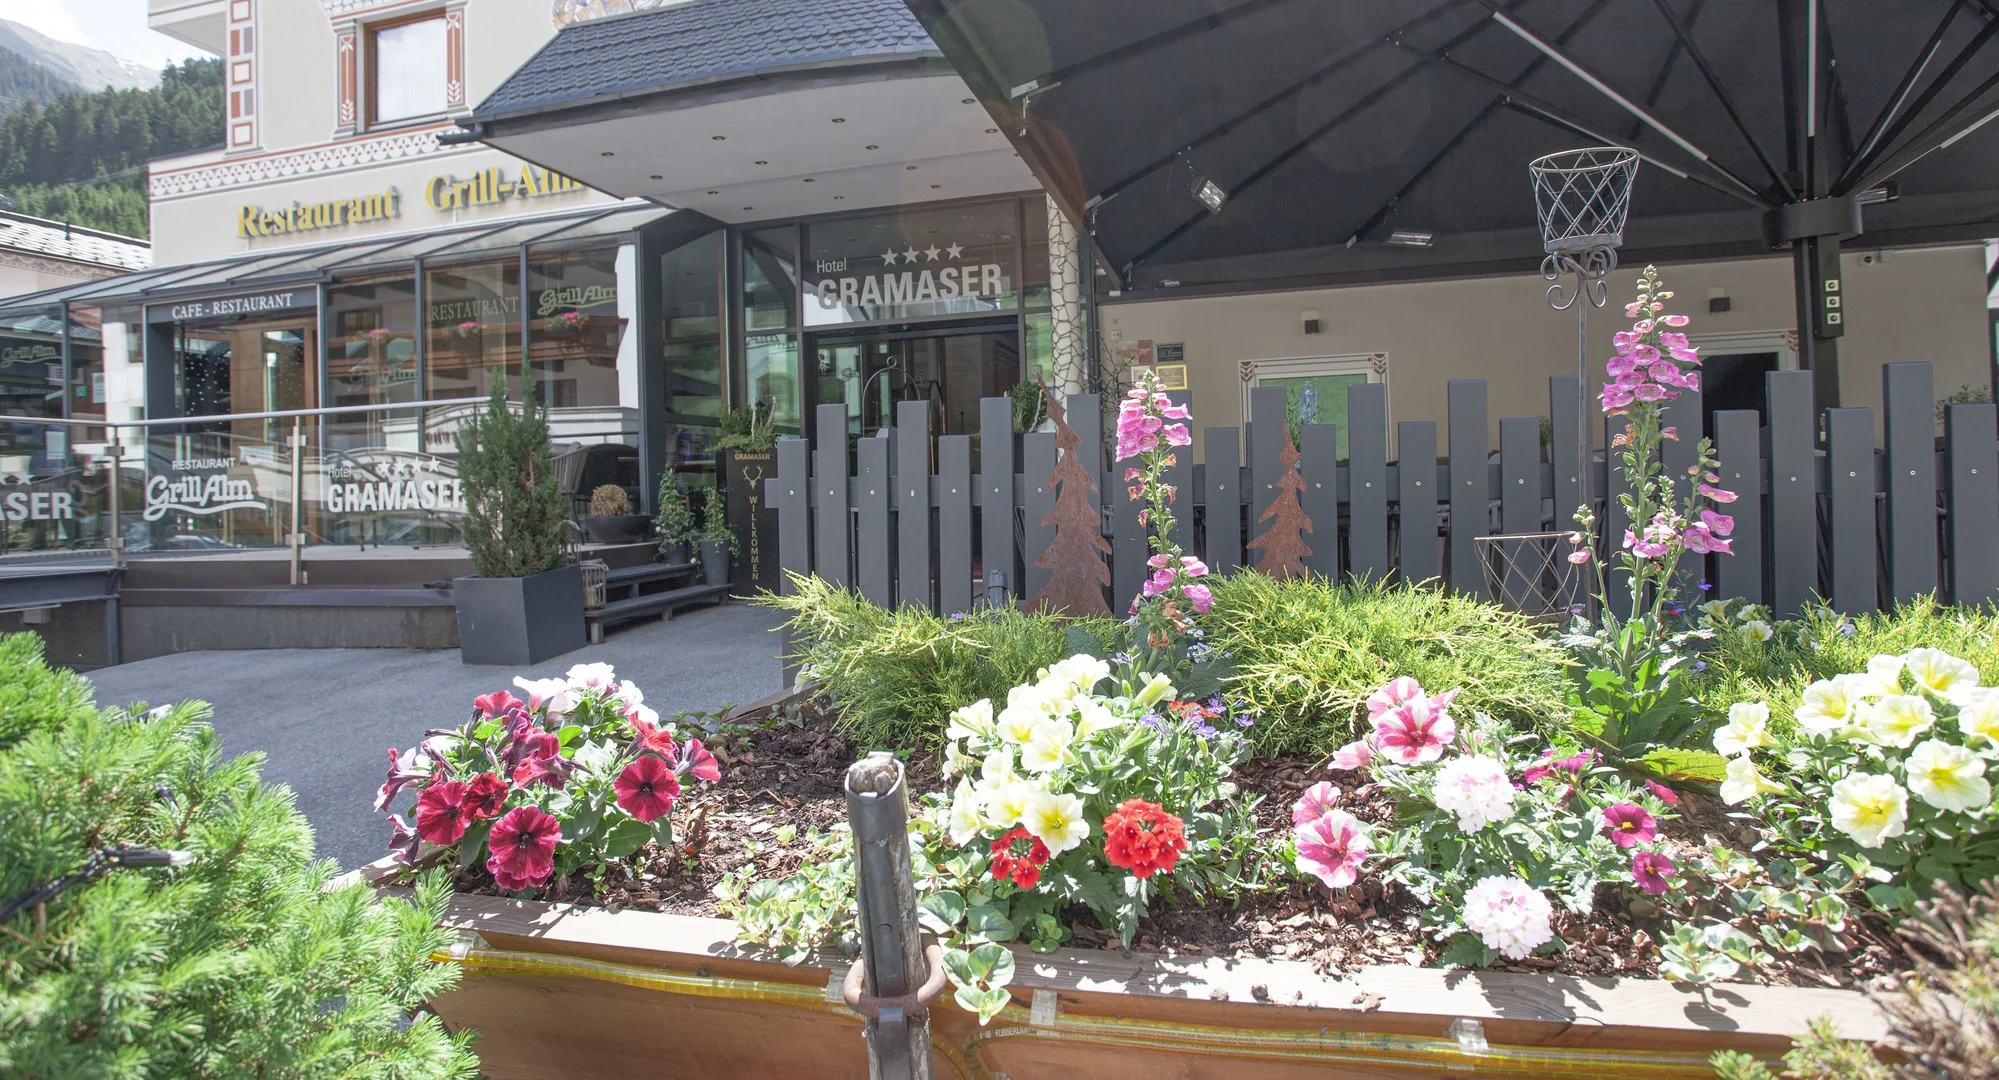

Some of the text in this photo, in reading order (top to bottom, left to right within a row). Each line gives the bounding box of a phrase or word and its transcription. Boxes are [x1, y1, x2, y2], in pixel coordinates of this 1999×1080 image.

[236, 186, 400, 238] Restaurant
[816, 257, 847, 273] Hotel
[818, 263, 1002, 310] GRAMASER
[172, 304, 203, 319] CAFE
[213, 293, 293, 315] RESTAURANT
[431, 296, 519, 321] RESTAURANT
[171, 457, 236, 471] RESTAURANT
[327, 466, 351, 479] Hotel
[748, 496, 759, 581] WILLKOMMEN
